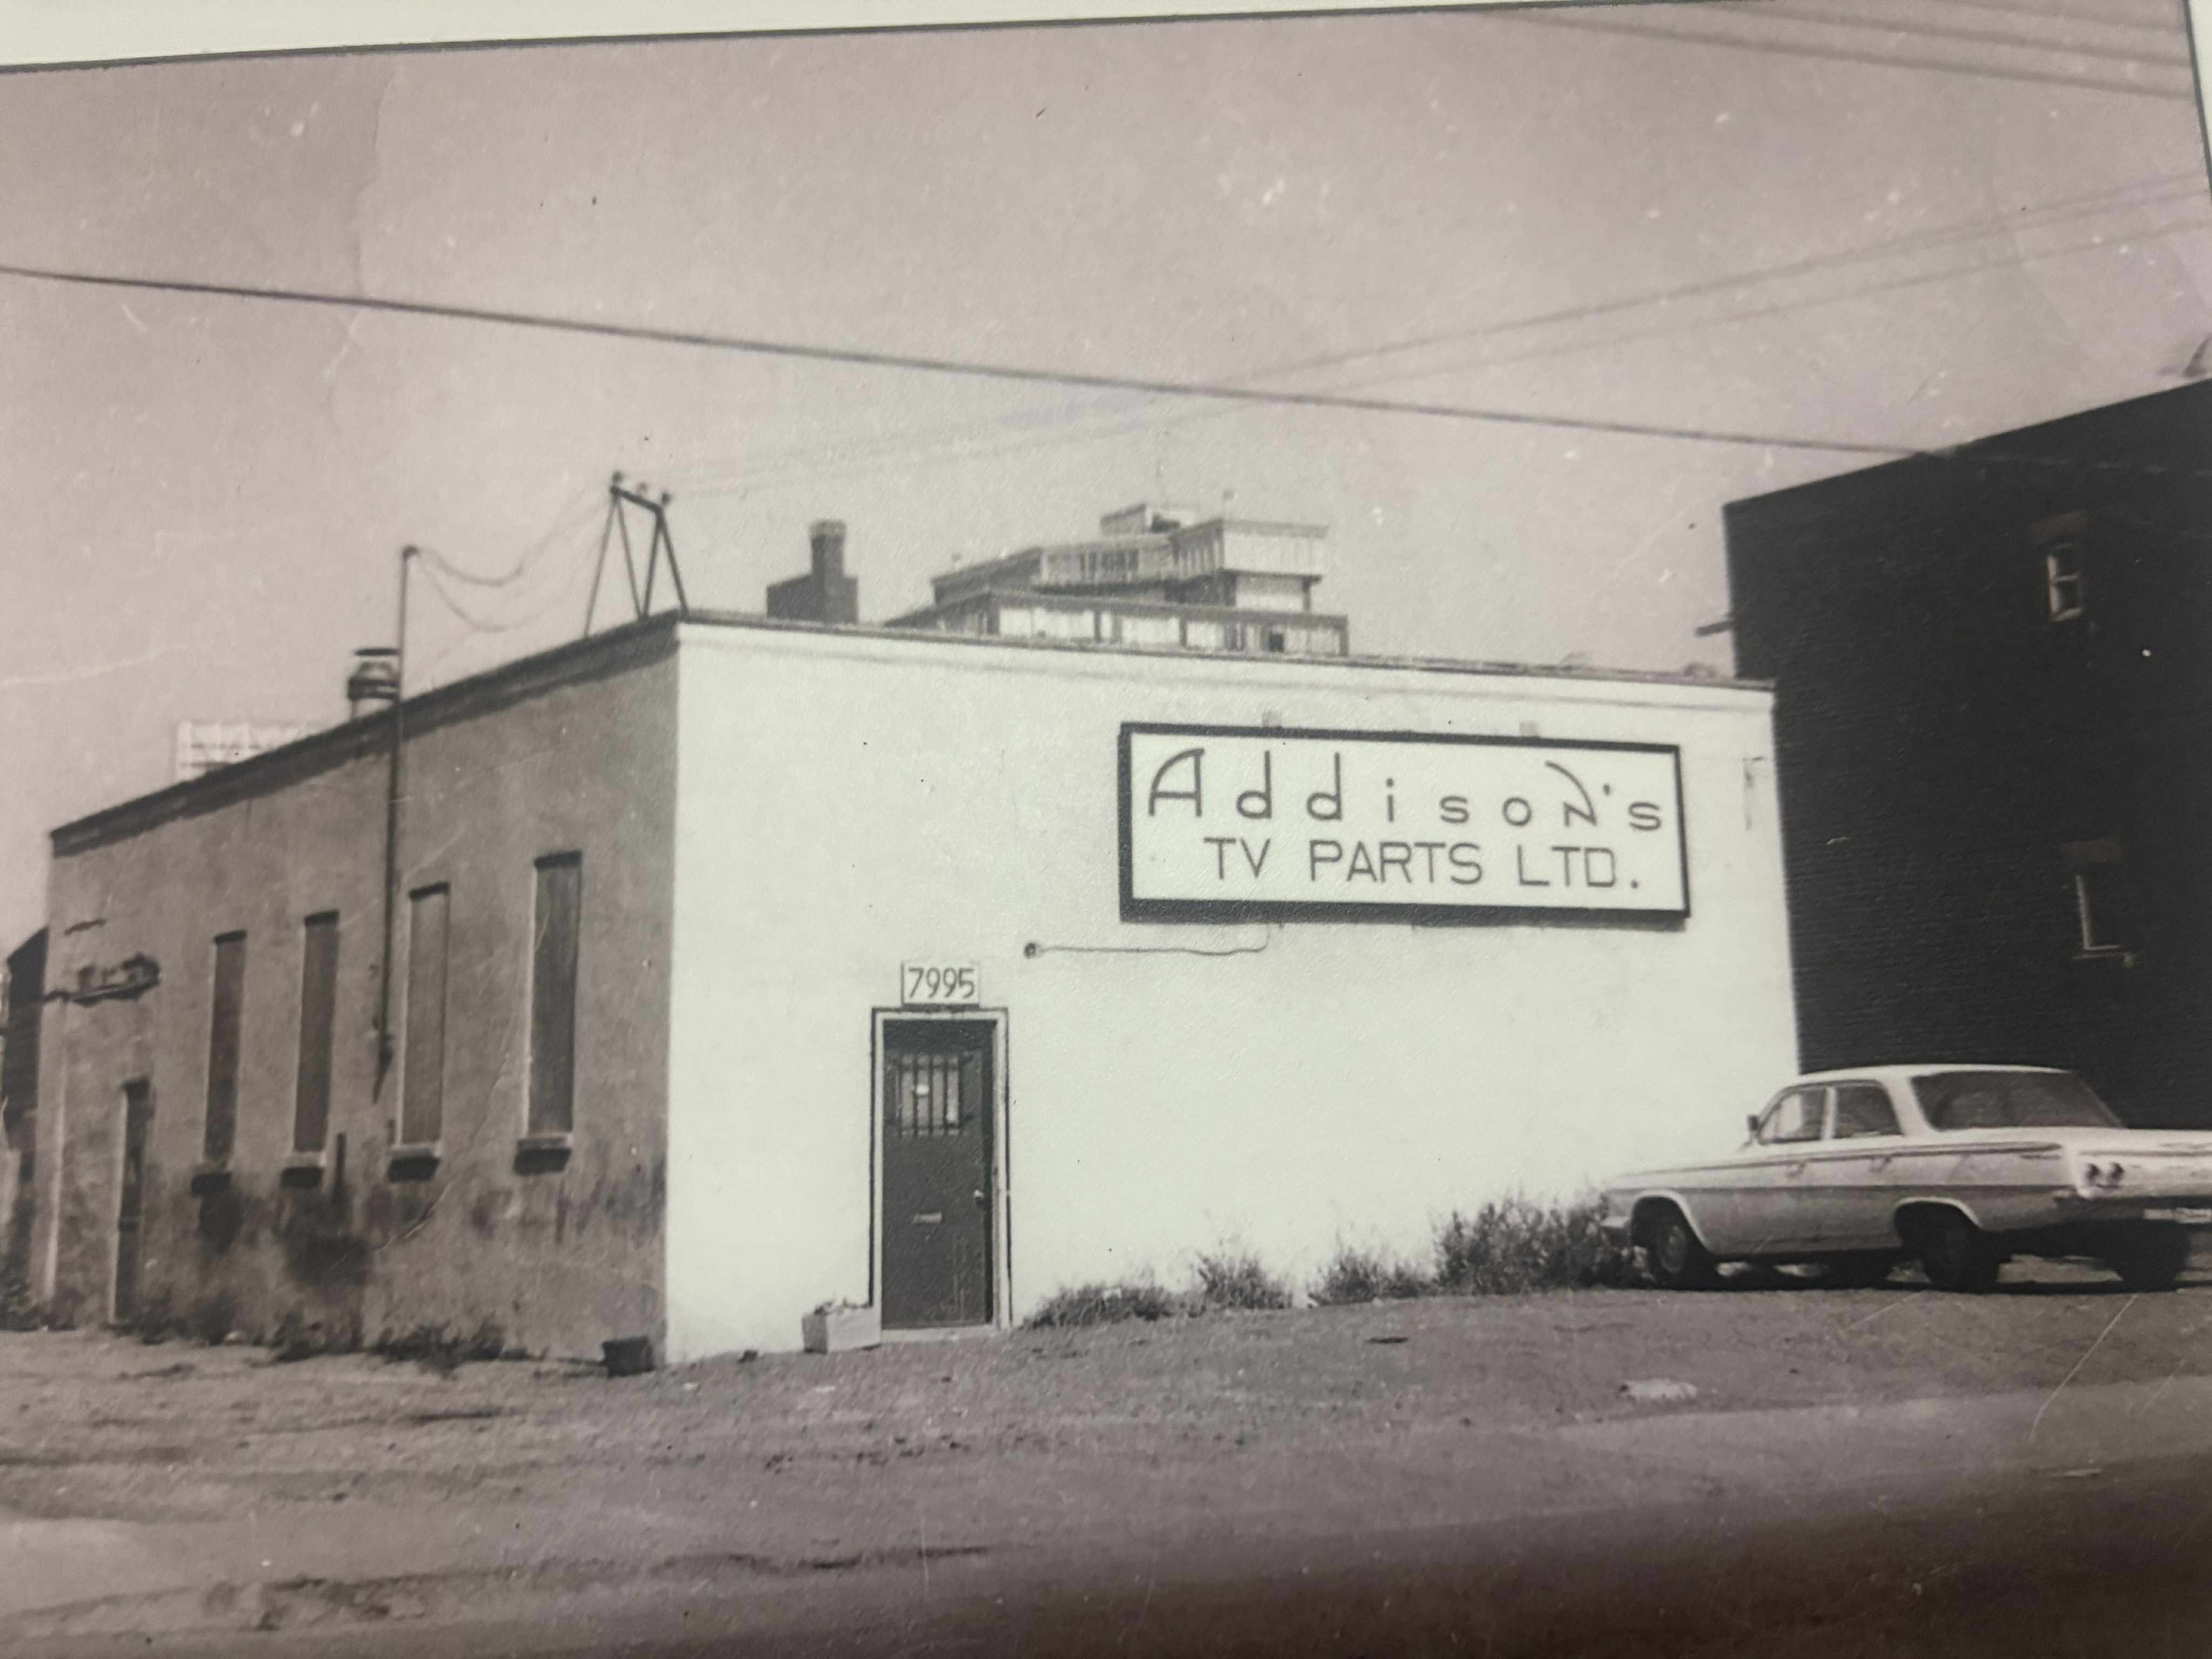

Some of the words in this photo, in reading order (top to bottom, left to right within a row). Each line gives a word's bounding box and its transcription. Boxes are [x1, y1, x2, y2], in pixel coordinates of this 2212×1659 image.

[1204, 838, 1271, 881] TV
[1310, 839, 1483, 885] PARTS
[1516, 844, 1640, 889] LTD.
[908, 967, 975, 998] 7995
